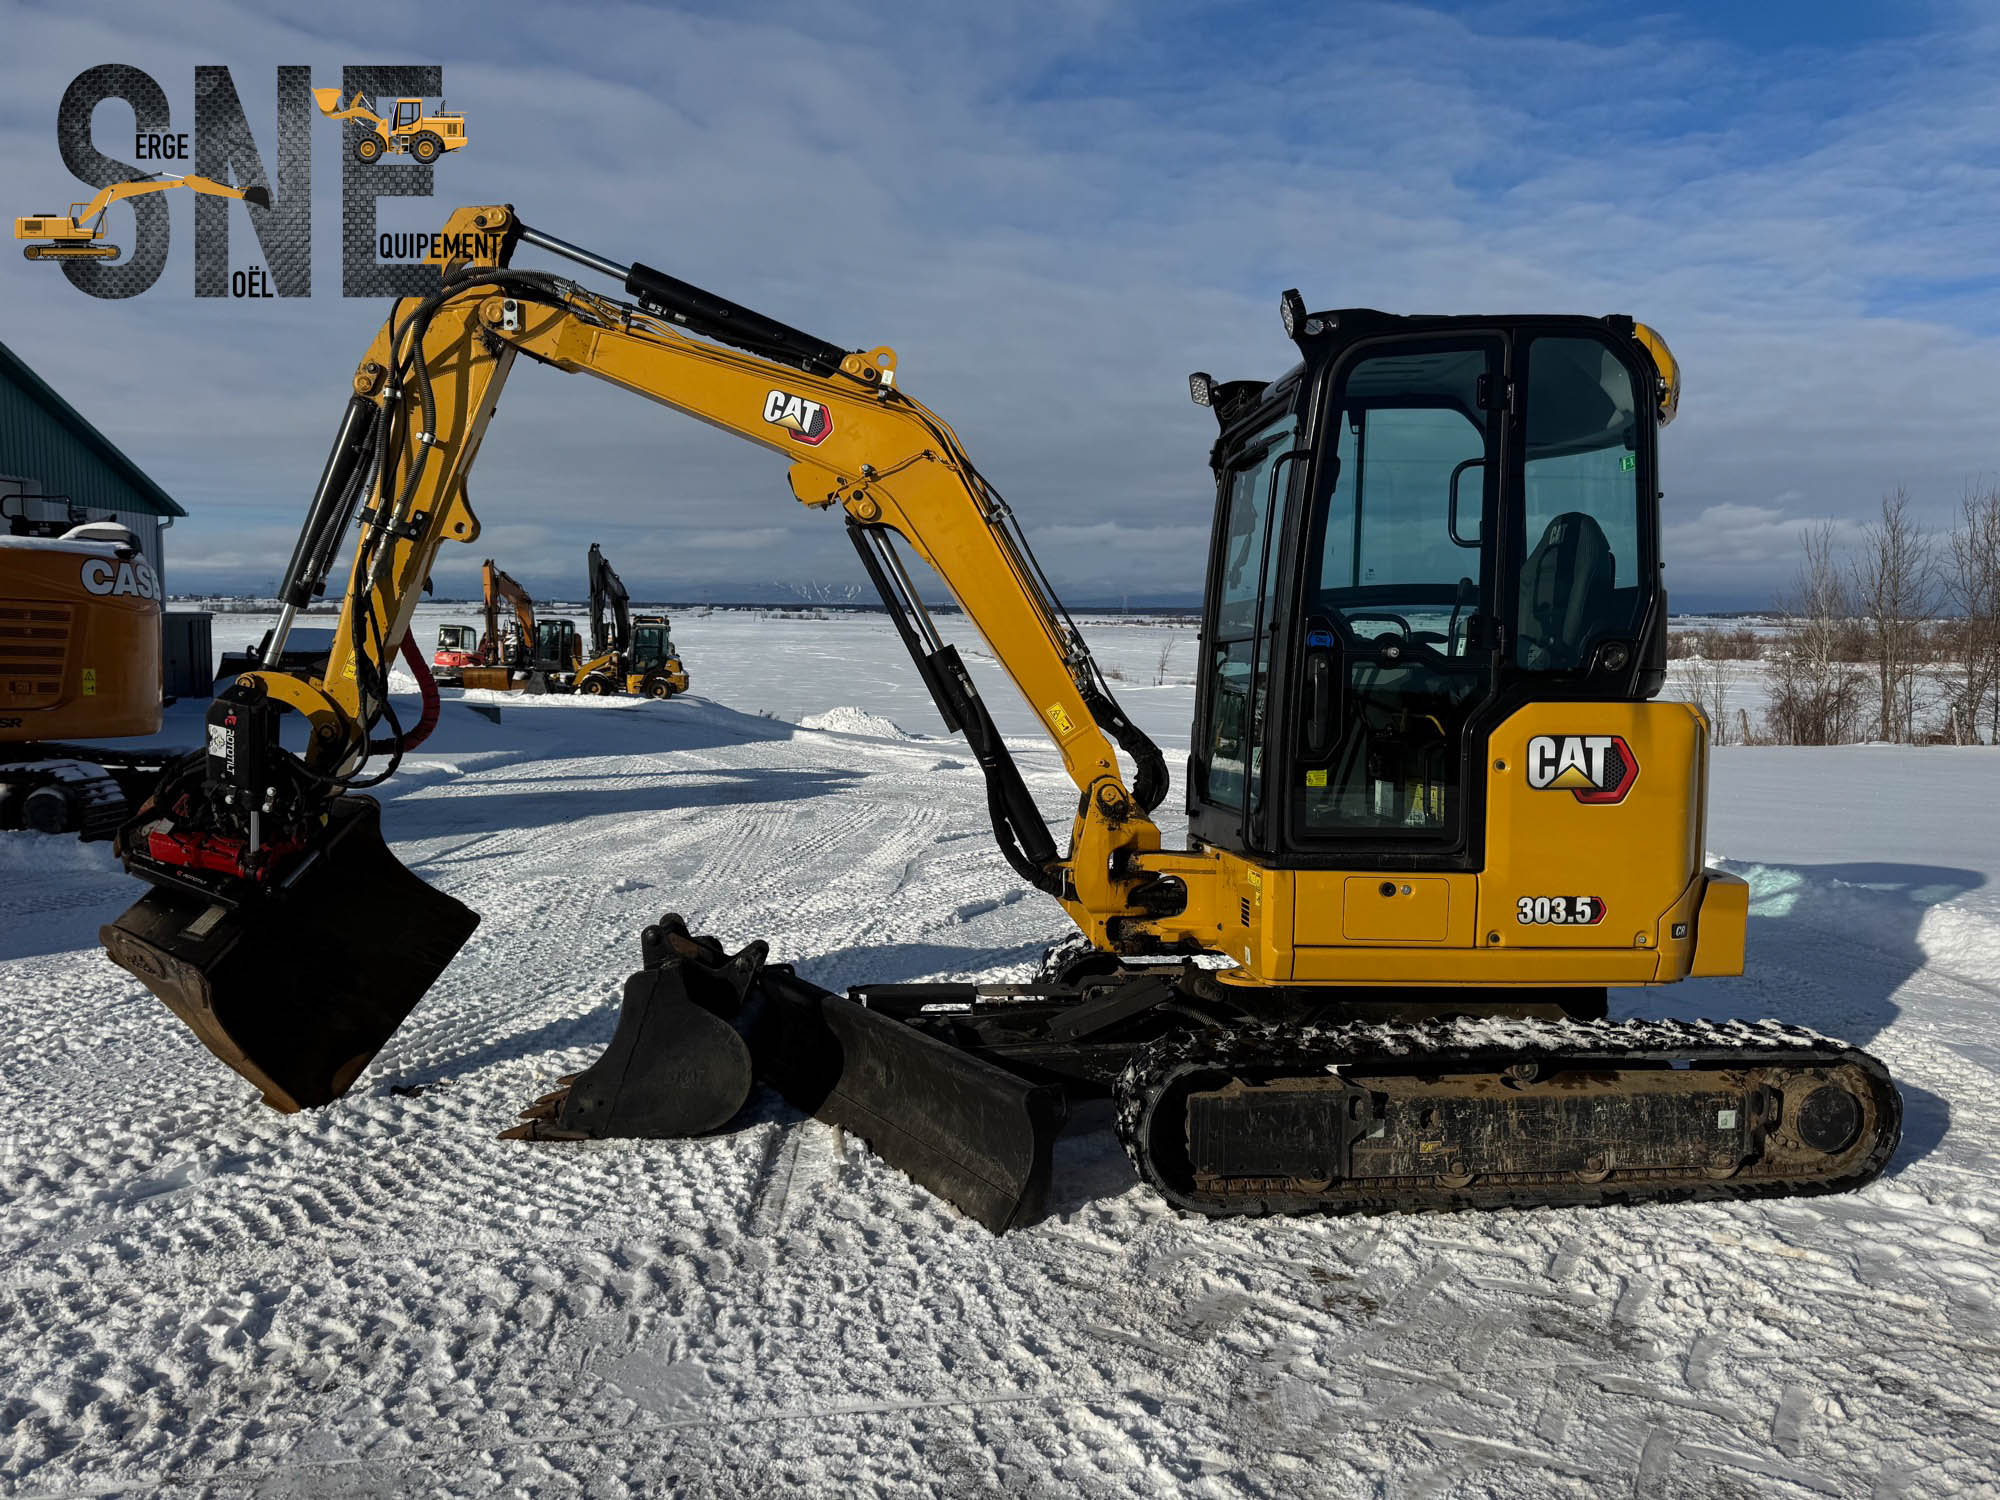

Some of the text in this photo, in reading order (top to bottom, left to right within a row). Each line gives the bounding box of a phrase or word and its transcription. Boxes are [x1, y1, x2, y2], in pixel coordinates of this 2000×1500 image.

[763, 390, 821, 434] CAT
[226, 729, 235, 776] ROTOTILT
[1528, 736, 1612, 788] CAT
[1517, 897, 1592, 924] 303.5
[1675, 924, 1686, 937] CR
